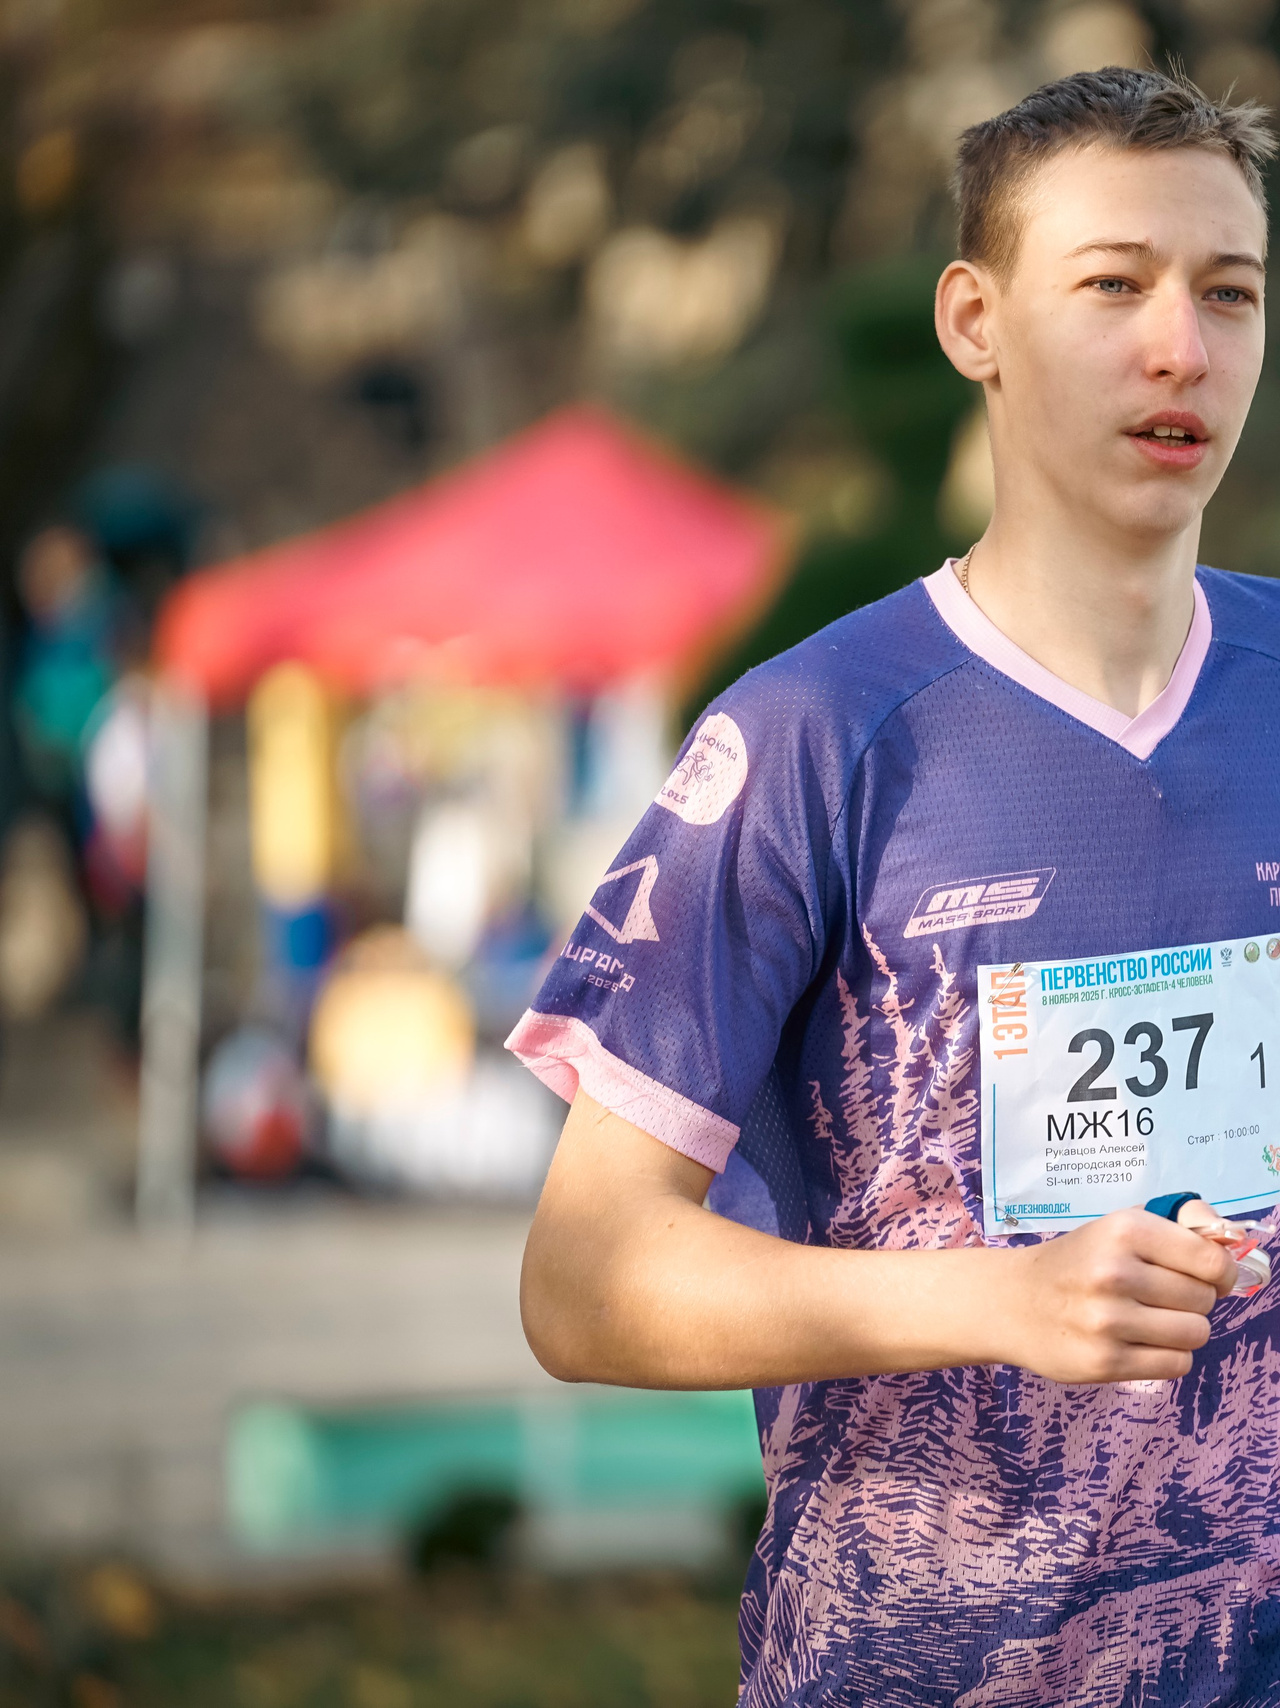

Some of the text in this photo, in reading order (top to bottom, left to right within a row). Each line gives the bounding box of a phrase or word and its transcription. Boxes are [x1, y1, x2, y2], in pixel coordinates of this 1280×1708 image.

[918, 905, 1026, 930] MASS SPORT
[1040, 947, 1212, 991] ПЕРВЕНСТВО РОССИИ
[1042, 995, 1048, 1006] 8
[1048, 993, 1080, 1006] НОЯБРЯ
[1080, 989, 1100, 1003] 2025
[1176, 974, 1213, 990] ЧЕЛОВЕКА
[990, 970, 1028, 1060] 1 ЭТАП
[1067, 1012, 1266, 1103] 237 1
[1046, 1107, 1154, 1142] МЖ16
[1187, 1133, 1215, 1146] Старт
[1223, 1125, 1260, 1140] 10:00:00
[1045, 1143, 1145, 1159] Рукавцов Алексей
[1046, 1157, 1148, 1172] Белгородская обл.
[1046, 1172, 1133, 1187] SI-чип: 8372310
[1004, 1202, 1071, 1216] ЖЕЛЕЗНОВОДСК
